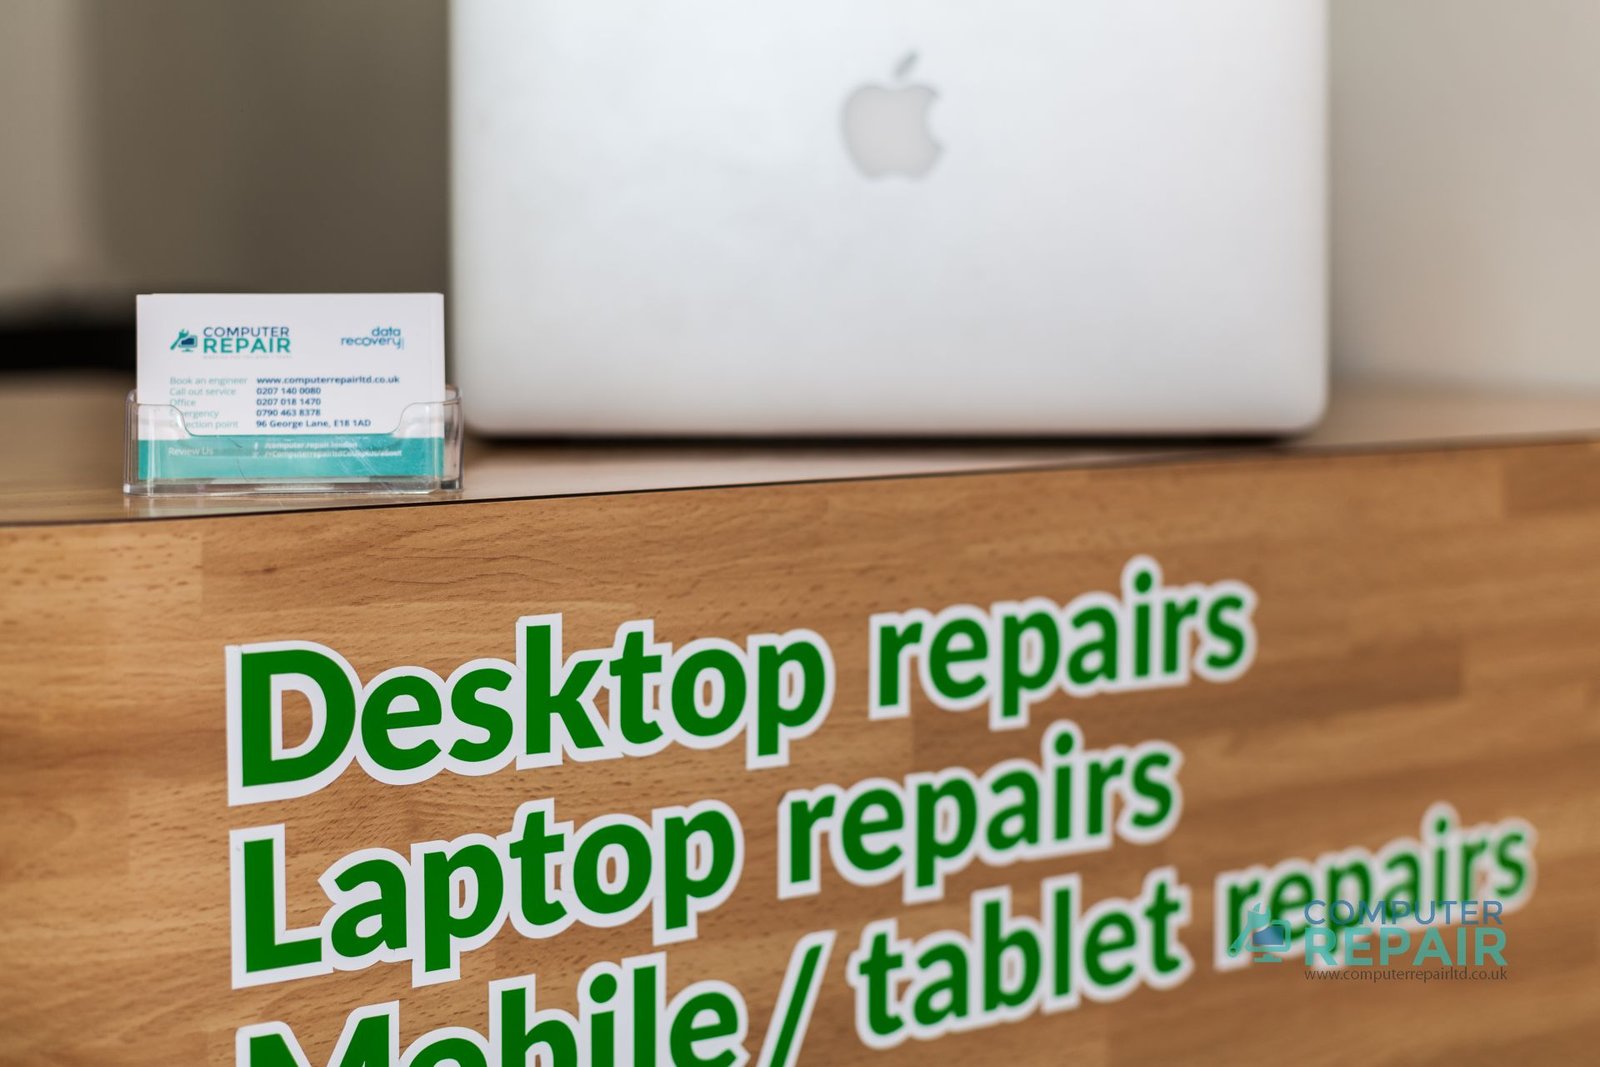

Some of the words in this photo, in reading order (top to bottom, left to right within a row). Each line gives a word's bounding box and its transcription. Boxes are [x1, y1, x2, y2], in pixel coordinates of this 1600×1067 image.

[202, 326, 290, 338] COMPUTER
[371, 325, 401, 337] data
[202, 337, 291, 353] REPAIR
[340, 336, 401, 350] recovery
[169, 376, 192, 385] Book
[195, 377, 207, 385] an
[208, 377, 248, 387] engineer
[256, 375, 400, 386] www.computerrepairltd.co.uk
[169, 387, 186, 396] Call
[188, 387, 203, 396] out
[206, 388, 236, 396] service
[256, 387, 278, 395] 0207
[281, 387, 297, 395] 140
[299, 387, 322, 395] 0080
[169, 398, 196, 407] Office
[256, 398, 278, 406] 0207
[280, 398, 297, 406] 018
[299, 398, 322, 406] 1470
[256, 409, 278, 417] 0790
[280, 409, 297, 417] 463
[215, 420, 239, 430] point
[256, 420, 268, 428] 96
[269, 419, 303, 429] George
[334, 419, 350, 427] E18
[353, 419, 372, 427] 1AD
[168, 446, 199, 456] Review
[201, 446, 214, 456] Us
[236, 616, 830, 792] Desktop
[874, 564, 1251, 722] repairs
[239, 805, 740, 978] Laptop
[785, 727, 1178, 891] repairs
[245, 961, 742, 1067] bile
[854, 876, 1187, 1040] tablet
[1222, 813, 1532, 960] repairs
